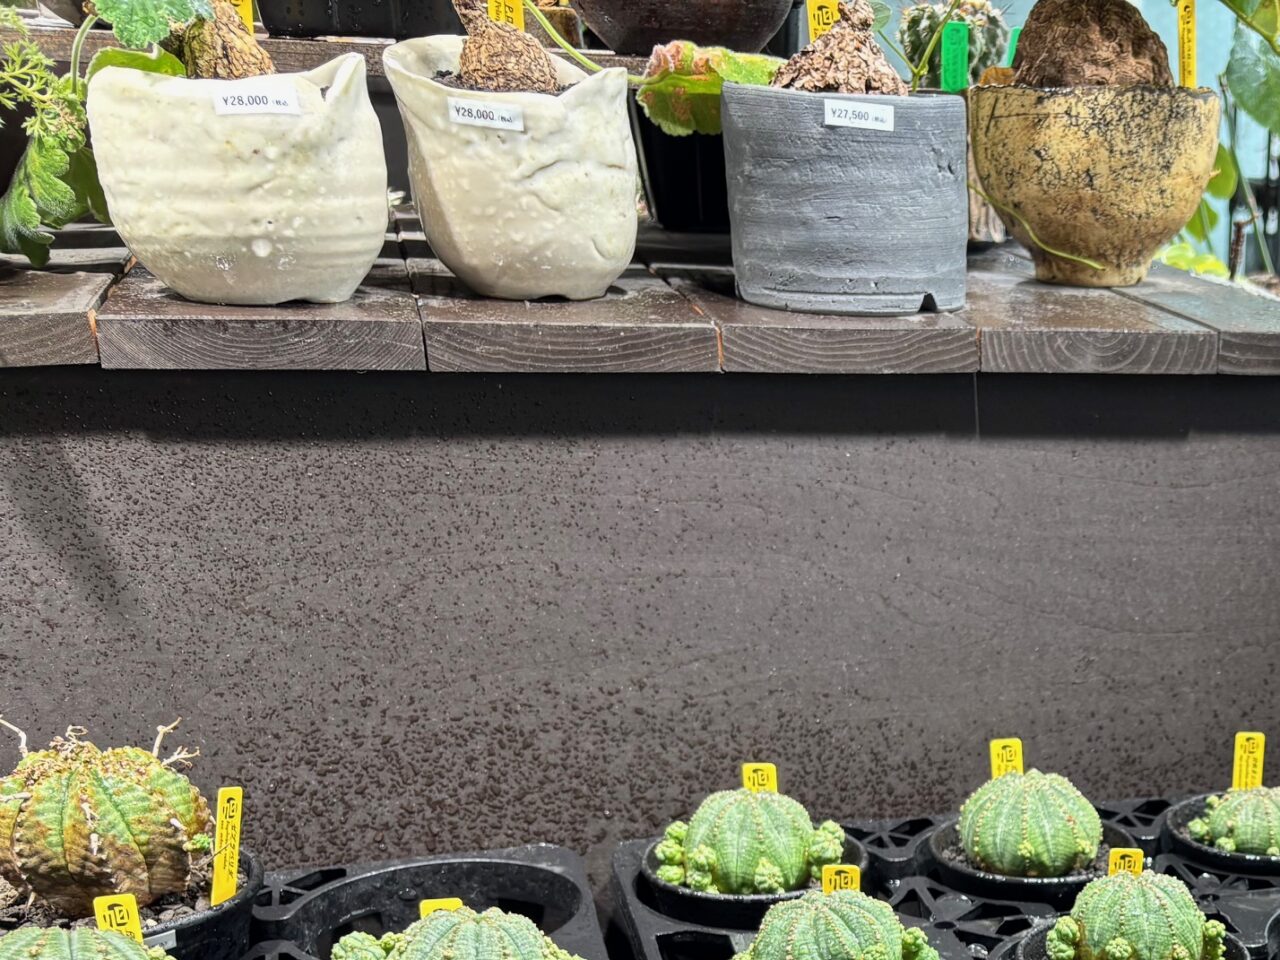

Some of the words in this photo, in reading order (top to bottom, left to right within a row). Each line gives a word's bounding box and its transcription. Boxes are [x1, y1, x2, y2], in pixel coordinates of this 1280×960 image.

[222, 95, 269, 106] ¥28,000
[454, 105, 495, 121] ¥28,000
[830, 107, 870, 121] ¥27,500
